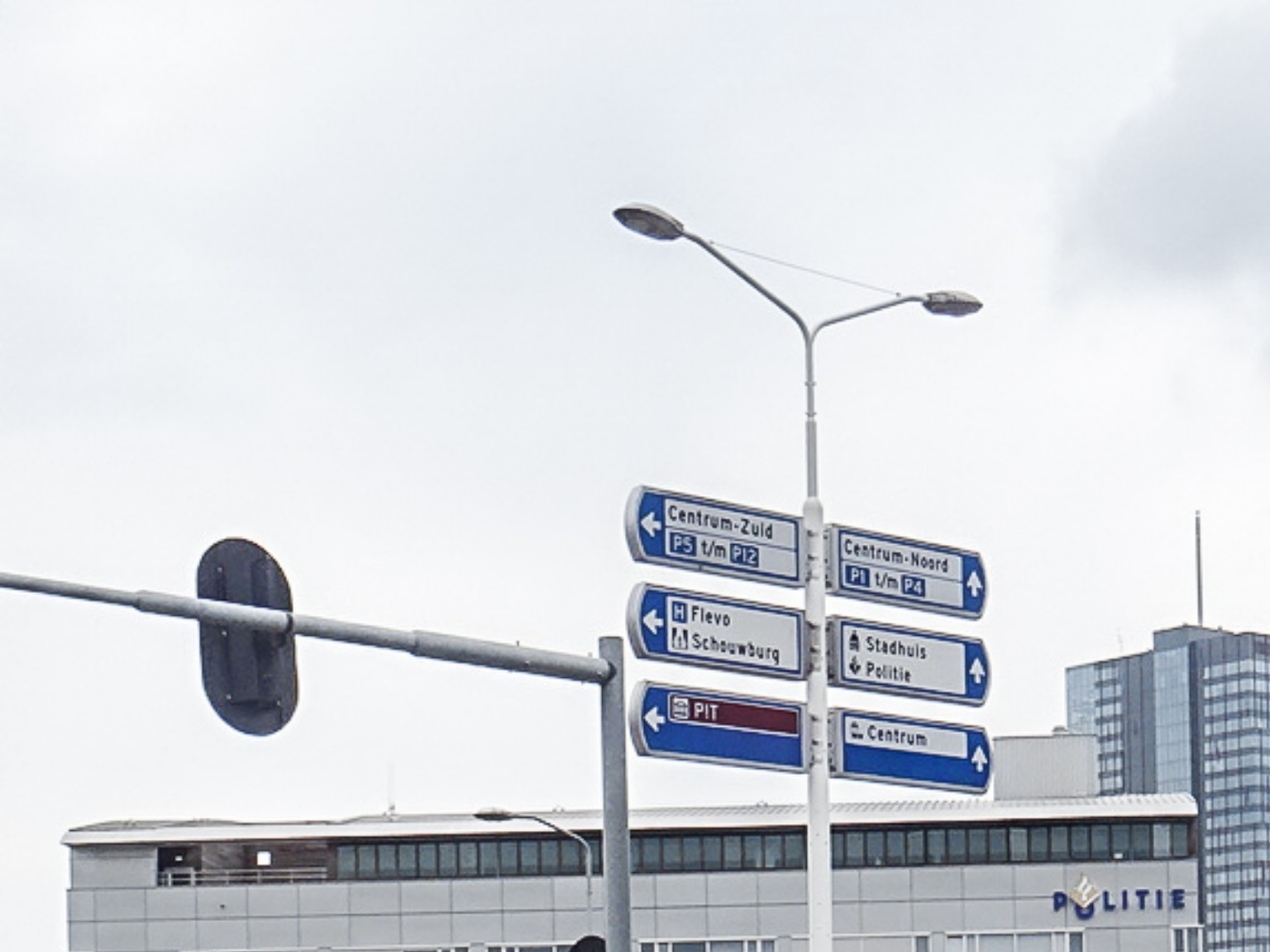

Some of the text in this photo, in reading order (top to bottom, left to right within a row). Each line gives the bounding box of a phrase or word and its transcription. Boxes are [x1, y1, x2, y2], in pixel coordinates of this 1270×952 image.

[668, 505, 773, 539] Centrum-Zuid
[701, 540, 727, 558] t/m
[732, 549, 757, 564] P12
[844, 539, 949, 573] Centrum-Noord
[852, 570, 922, 595] P1 t/m P4
[692, 606, 731, 627] Flevo
[692, 634, 780, 665] Schouwburg
[866, 636, 927, 660] Stadhuis
[866, 662, 911, 683] Politie
[694, 702, 719, 721] PIT
[868, 724, 928, 746] Centrum
[1053, 888, 1186, 921] POLITIE
